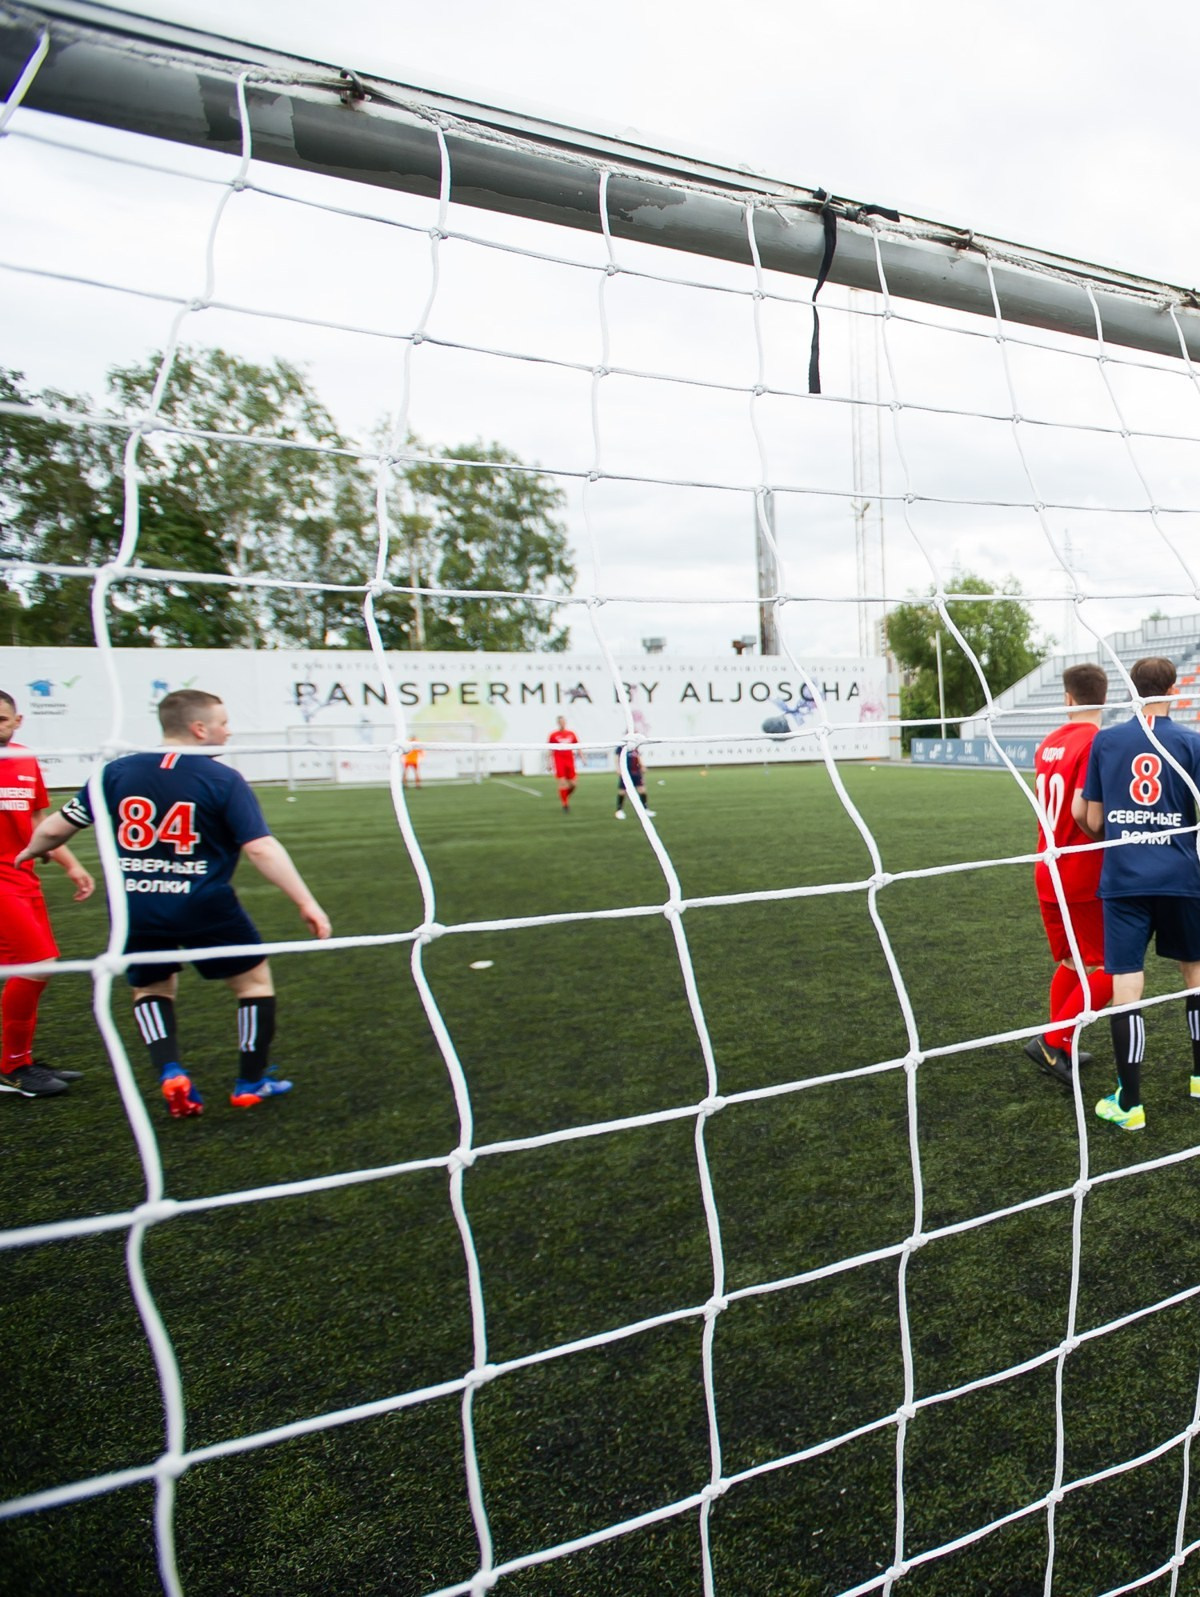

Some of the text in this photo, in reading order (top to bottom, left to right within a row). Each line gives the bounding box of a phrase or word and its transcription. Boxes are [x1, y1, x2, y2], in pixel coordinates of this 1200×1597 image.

[294, 681, 861, 706] PANSPERMIA BY ALJOSCHA
[1129, 752, 1163, 806] 8
[1035, 772, 1065, 833] 10
[117, 796, 201, 855] 84
[1107, 809, 1183, 827] СЕВЕРНЫЕ
[1121, 830, 1171, 846] ВОЛКИ
[118, 857, 208, 875] ЕВЕРНЫЕ
[125, 878, 191, 894] ВОЛКИ
